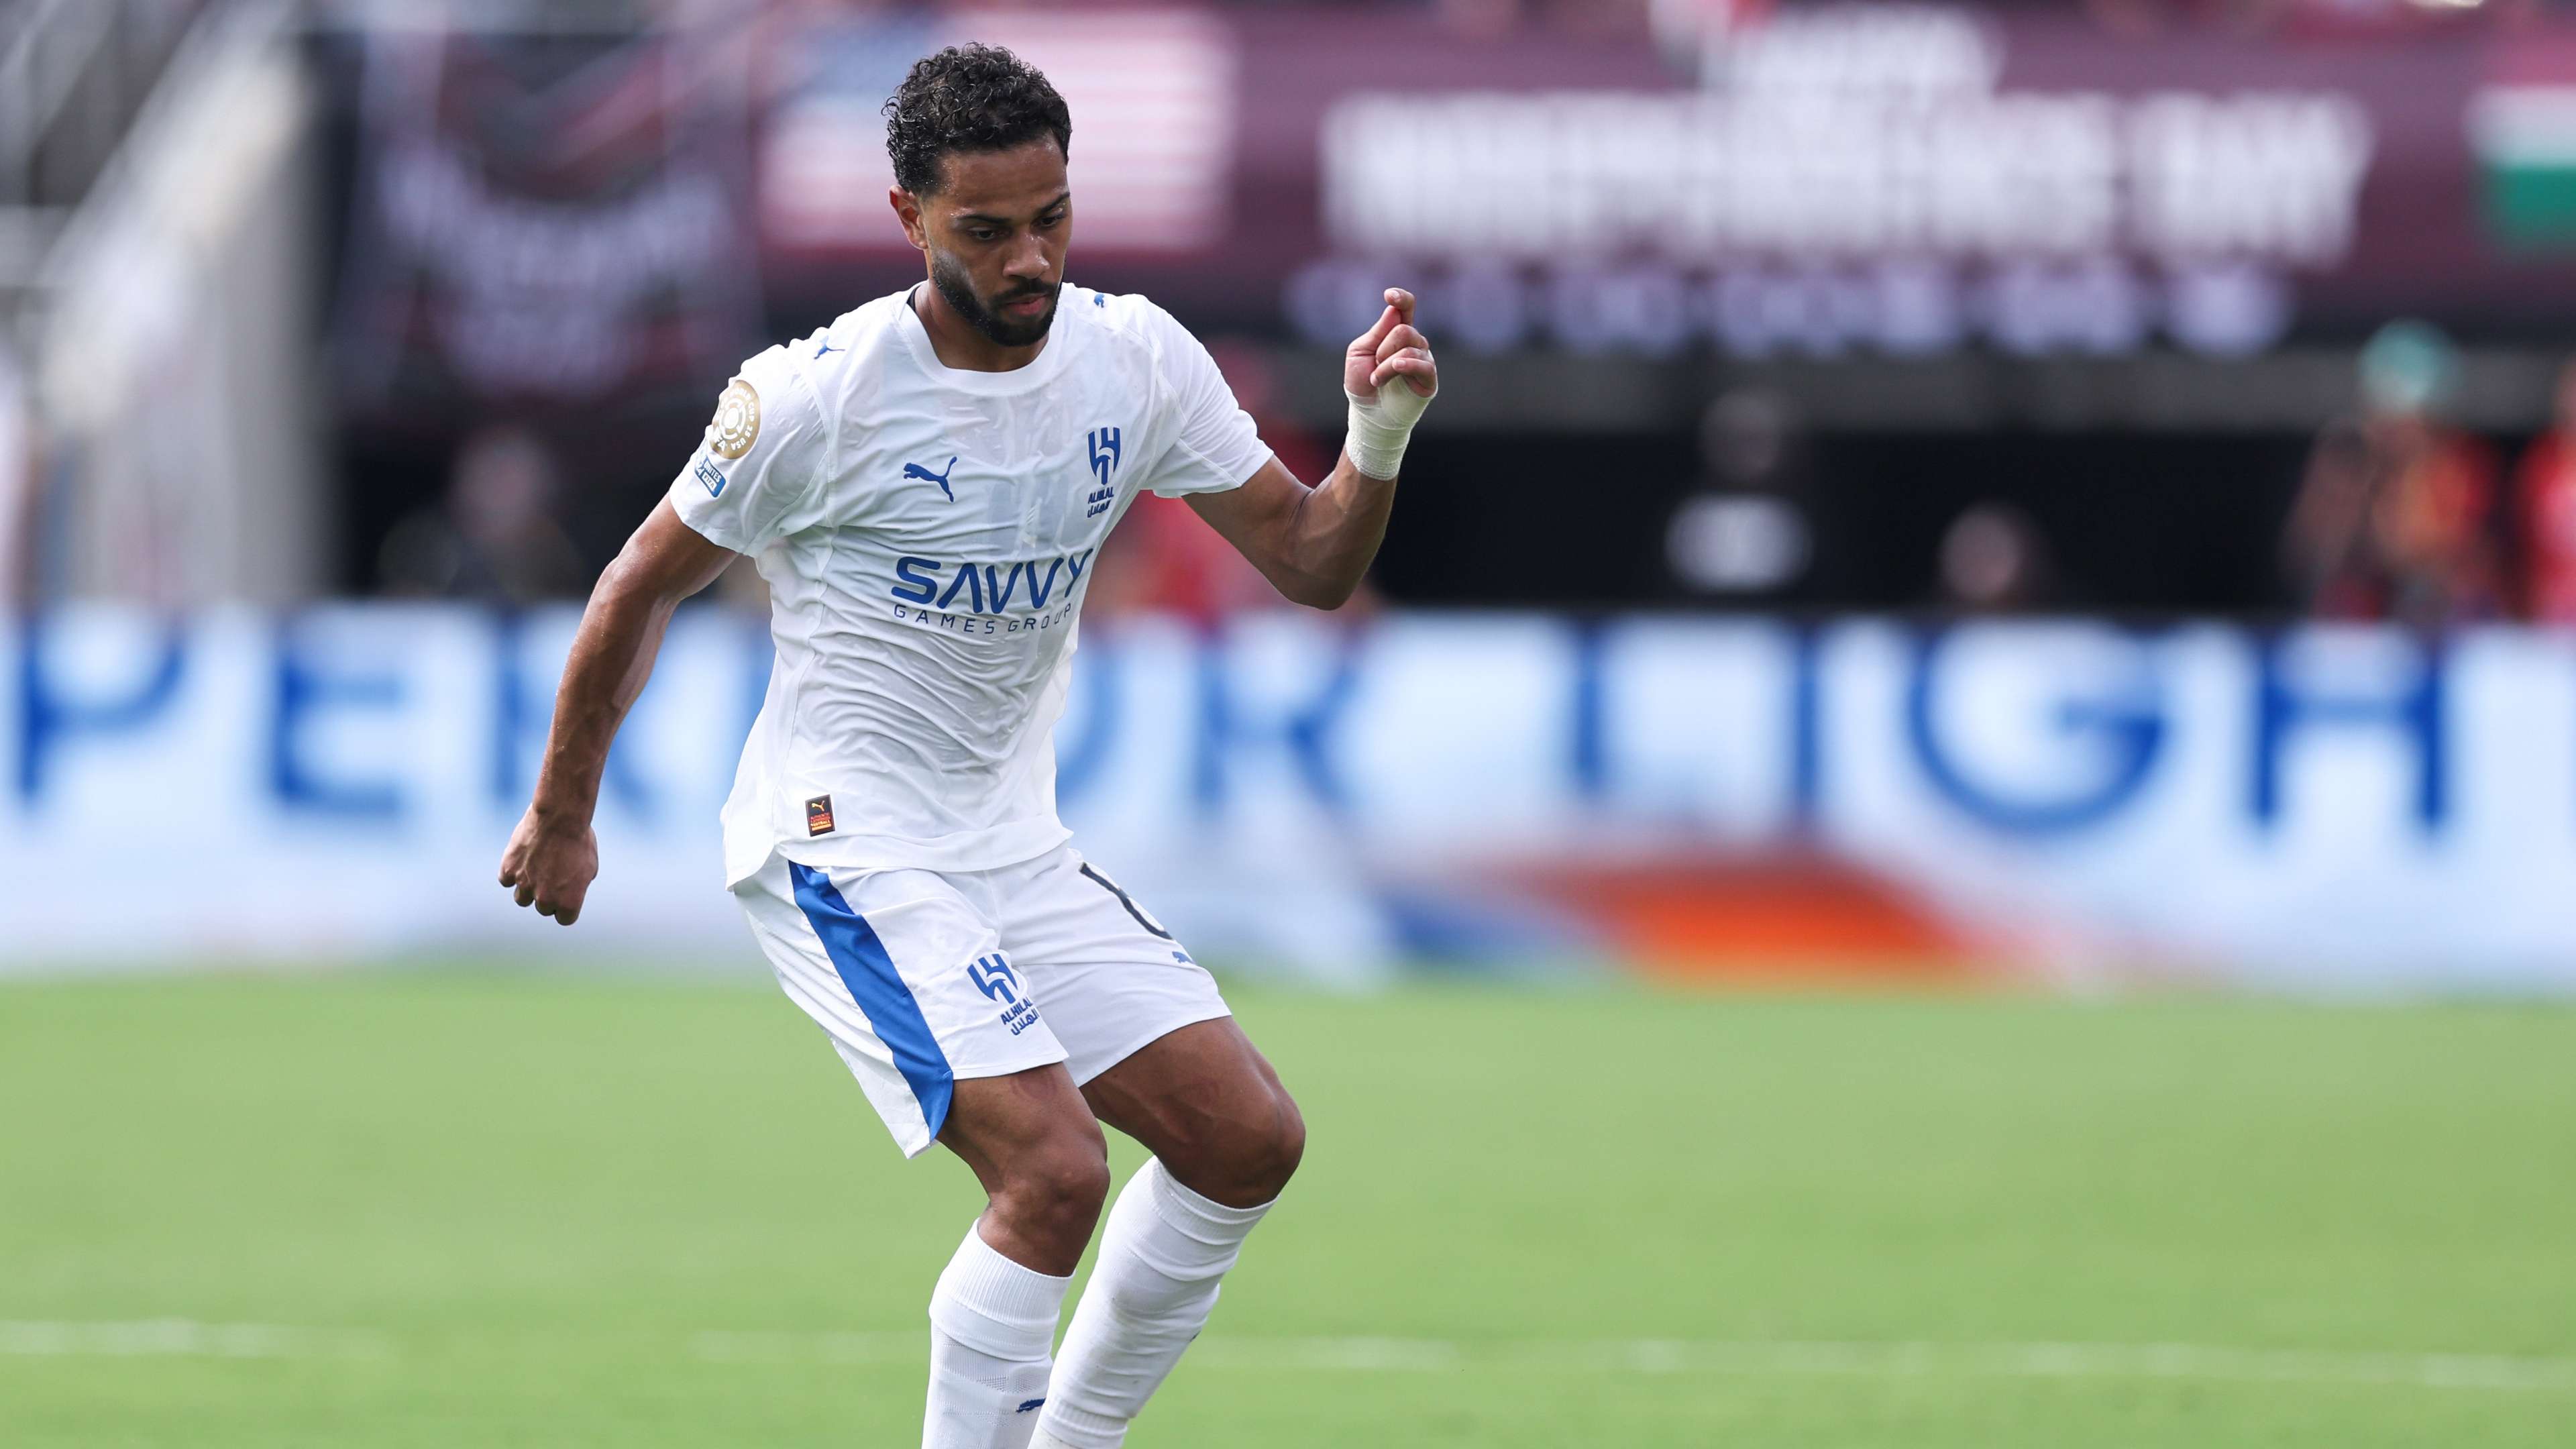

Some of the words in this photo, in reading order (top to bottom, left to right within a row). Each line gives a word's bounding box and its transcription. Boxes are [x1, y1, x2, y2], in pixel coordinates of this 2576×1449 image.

[731, 437, 746, 451] USA
[891, 548, 1093, 614] SAVVY
[894, 603, 995, 635] GAMES
[1008, 602, 1071, 633] GROUP
